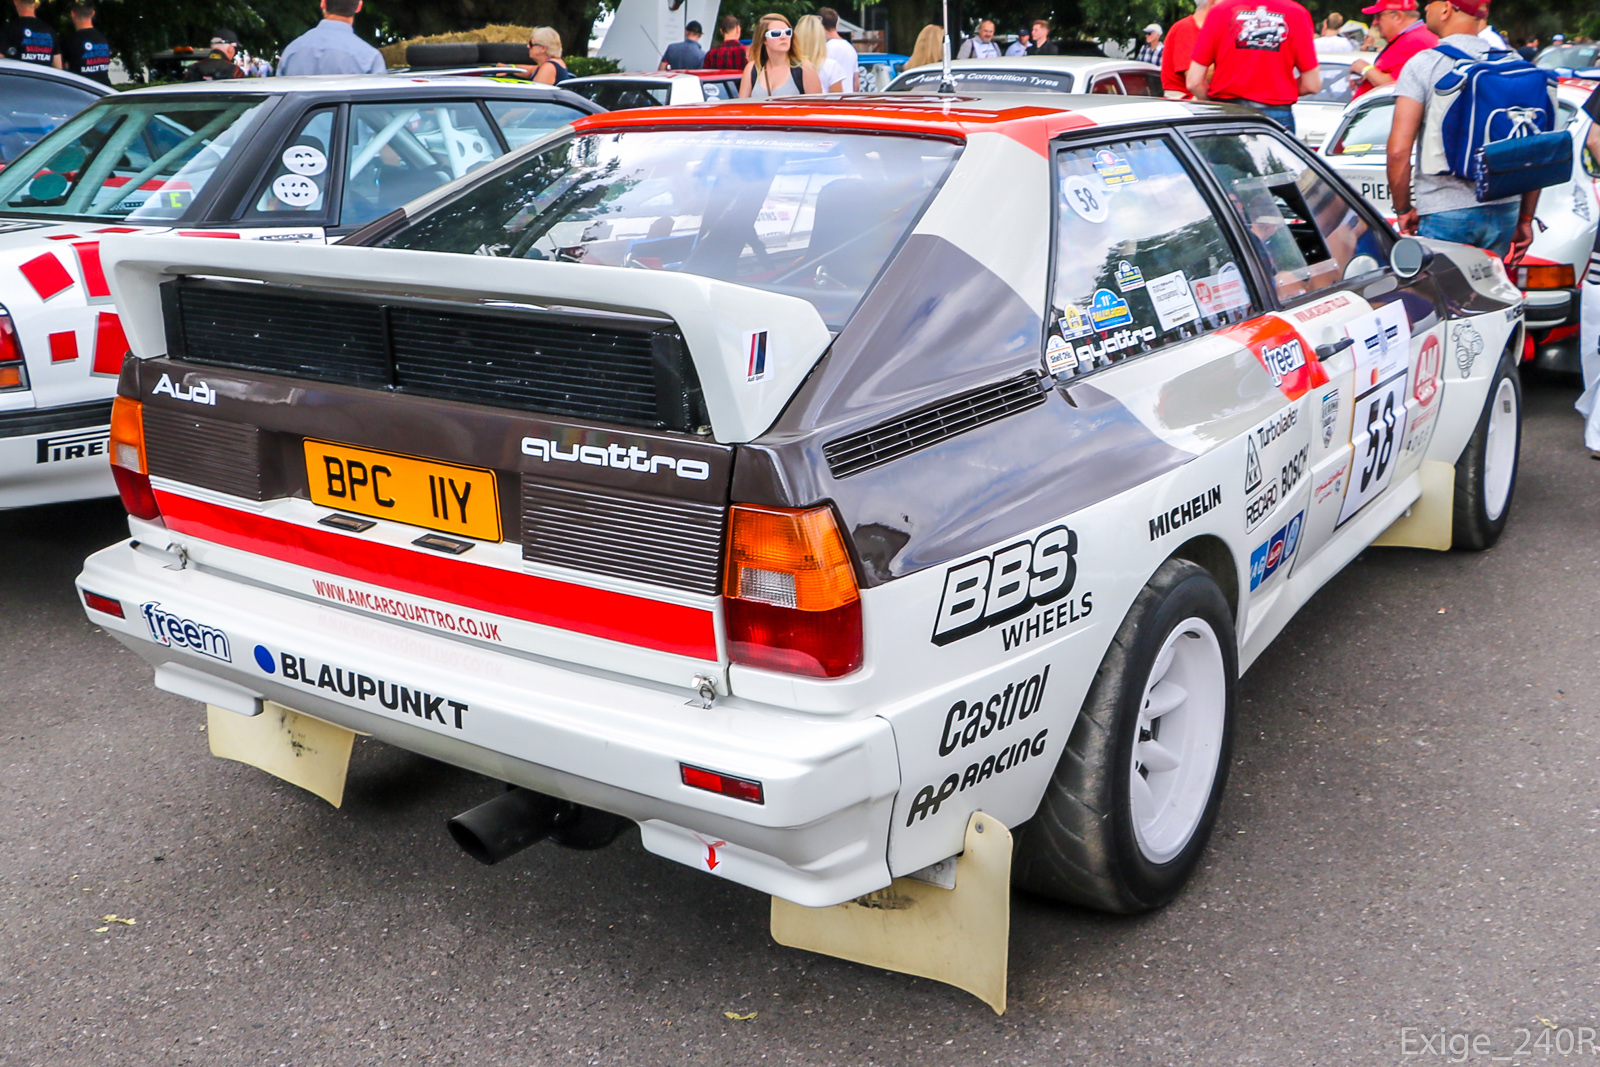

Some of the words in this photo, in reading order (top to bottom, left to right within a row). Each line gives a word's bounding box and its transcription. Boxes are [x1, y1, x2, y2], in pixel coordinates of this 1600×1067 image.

[967, 72, 1027, 83] Competition
[1030, 76, 1059, 88] Tyres
[1073, 187, 1099, 213] 58
[262, 232, 310, 241] LEGACY
[1076, 326, 1157, 362] quattro
[1262, 339, 1306, 388] freem
[152, 373, 216, 406] Audi
[1257, 408, 1298, 449] Turbolader
[1360, 390, 1396, 493] 58
[521, 436, 710, 481] quattro
[1281, 442, 1309, 499] BOSCH
[323, 455, 395, 508] BPC
[429, 475, 471, 524] 11Y
[1149, 484, 1221, 542] MICHELIN
[1246, 483, 1277, 529] RECARO
[312, 578, 502, 642] WWW.AMCARSQUATTRO.CO.UK
[931, 524, 1078, 647] BBS
[142, 602, 232, 664] freem
[1001, 591, 1092, 652] WHEELS
[281, 652, 469, 730] BLAUPUNKT
[938, 663, 1051, 757] Castrol
[906, 773, 960, 828] AP
[959, 728, 1049, 792] RACING
